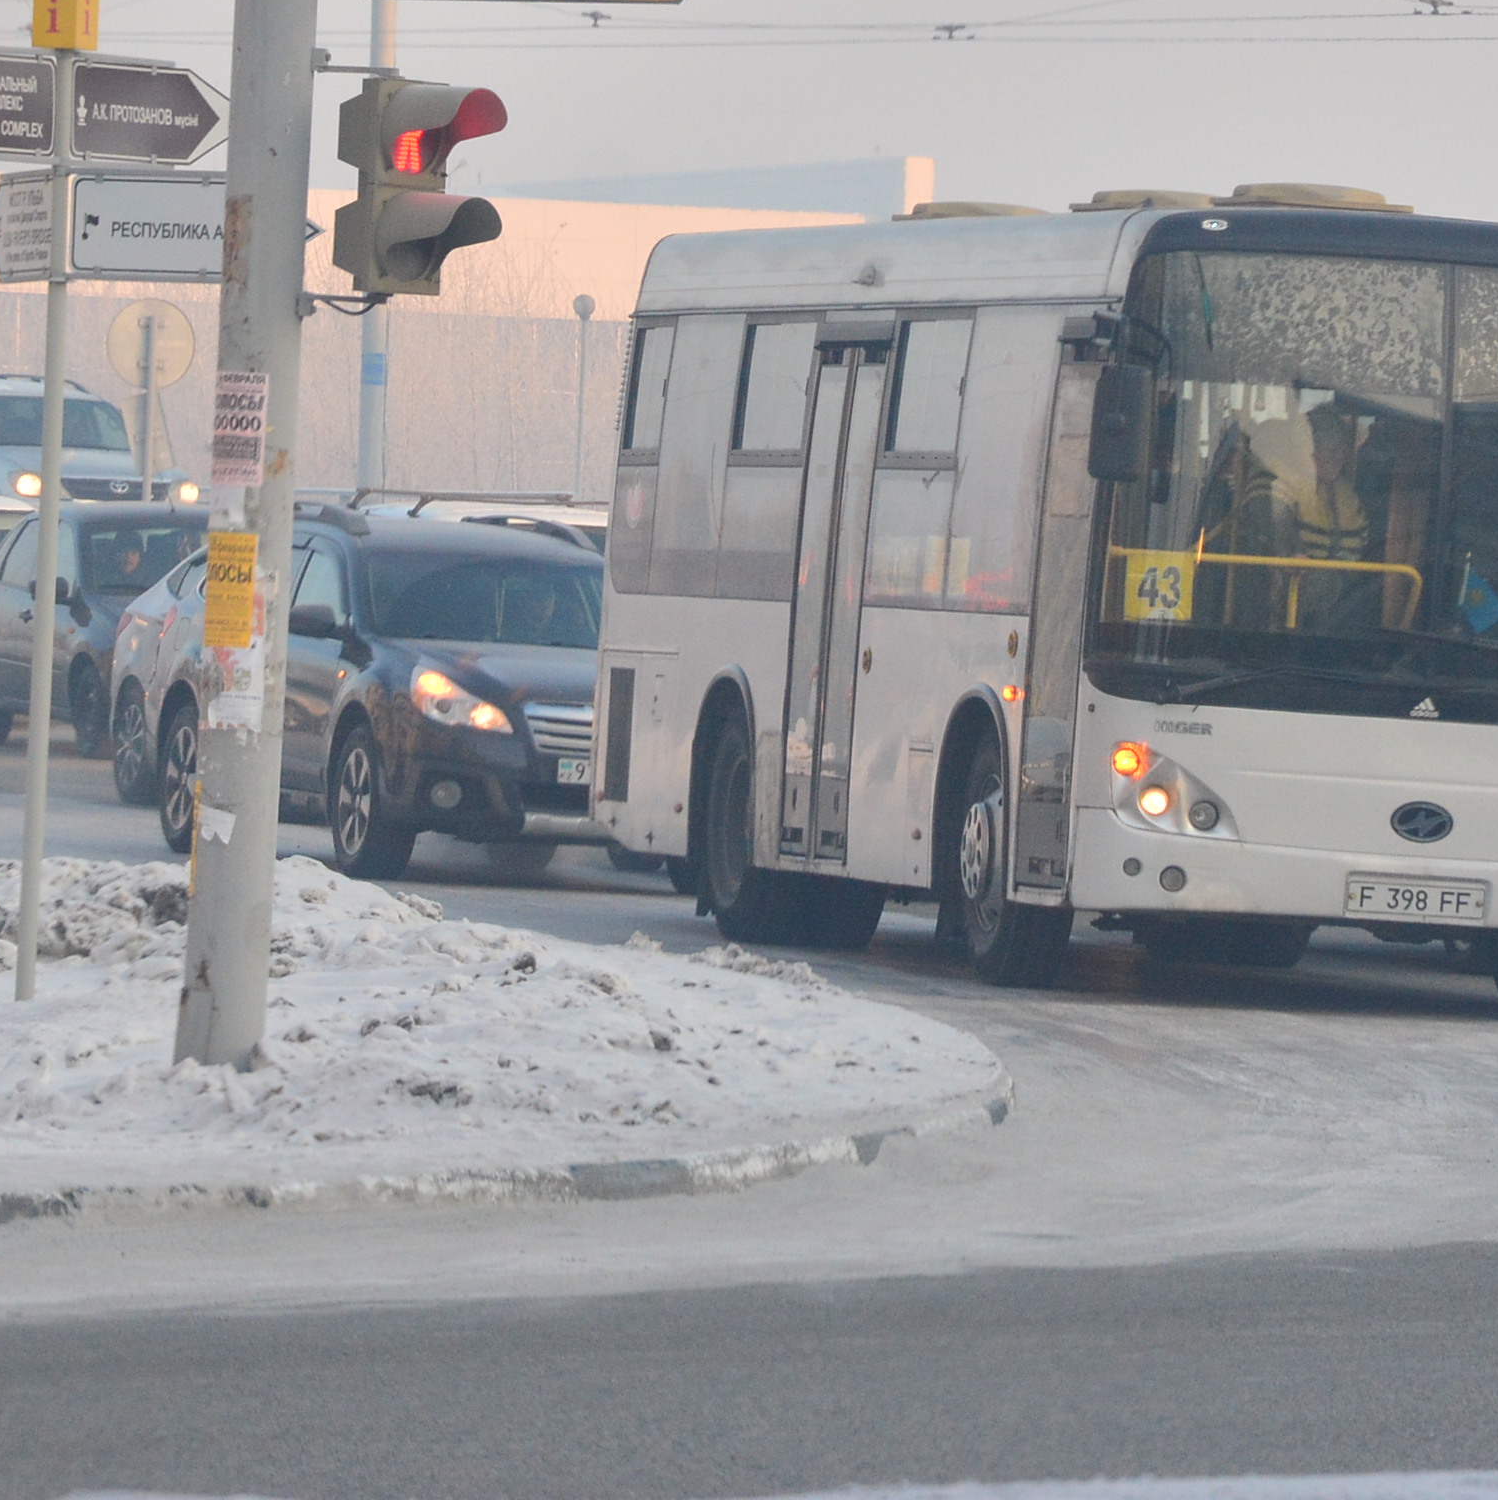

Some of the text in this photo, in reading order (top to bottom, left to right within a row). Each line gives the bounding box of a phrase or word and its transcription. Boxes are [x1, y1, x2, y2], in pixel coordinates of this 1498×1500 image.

[110, 106, 173, 126] ПРОТОЗАНОВ
[0, 117, 44, 139] COMPLEX
[111, 221, 209, 241] РЕСПУБЛИКА
[1137, 566, 1181, 609] 43
[1359, 885, 1471, 914] F 398 FF
